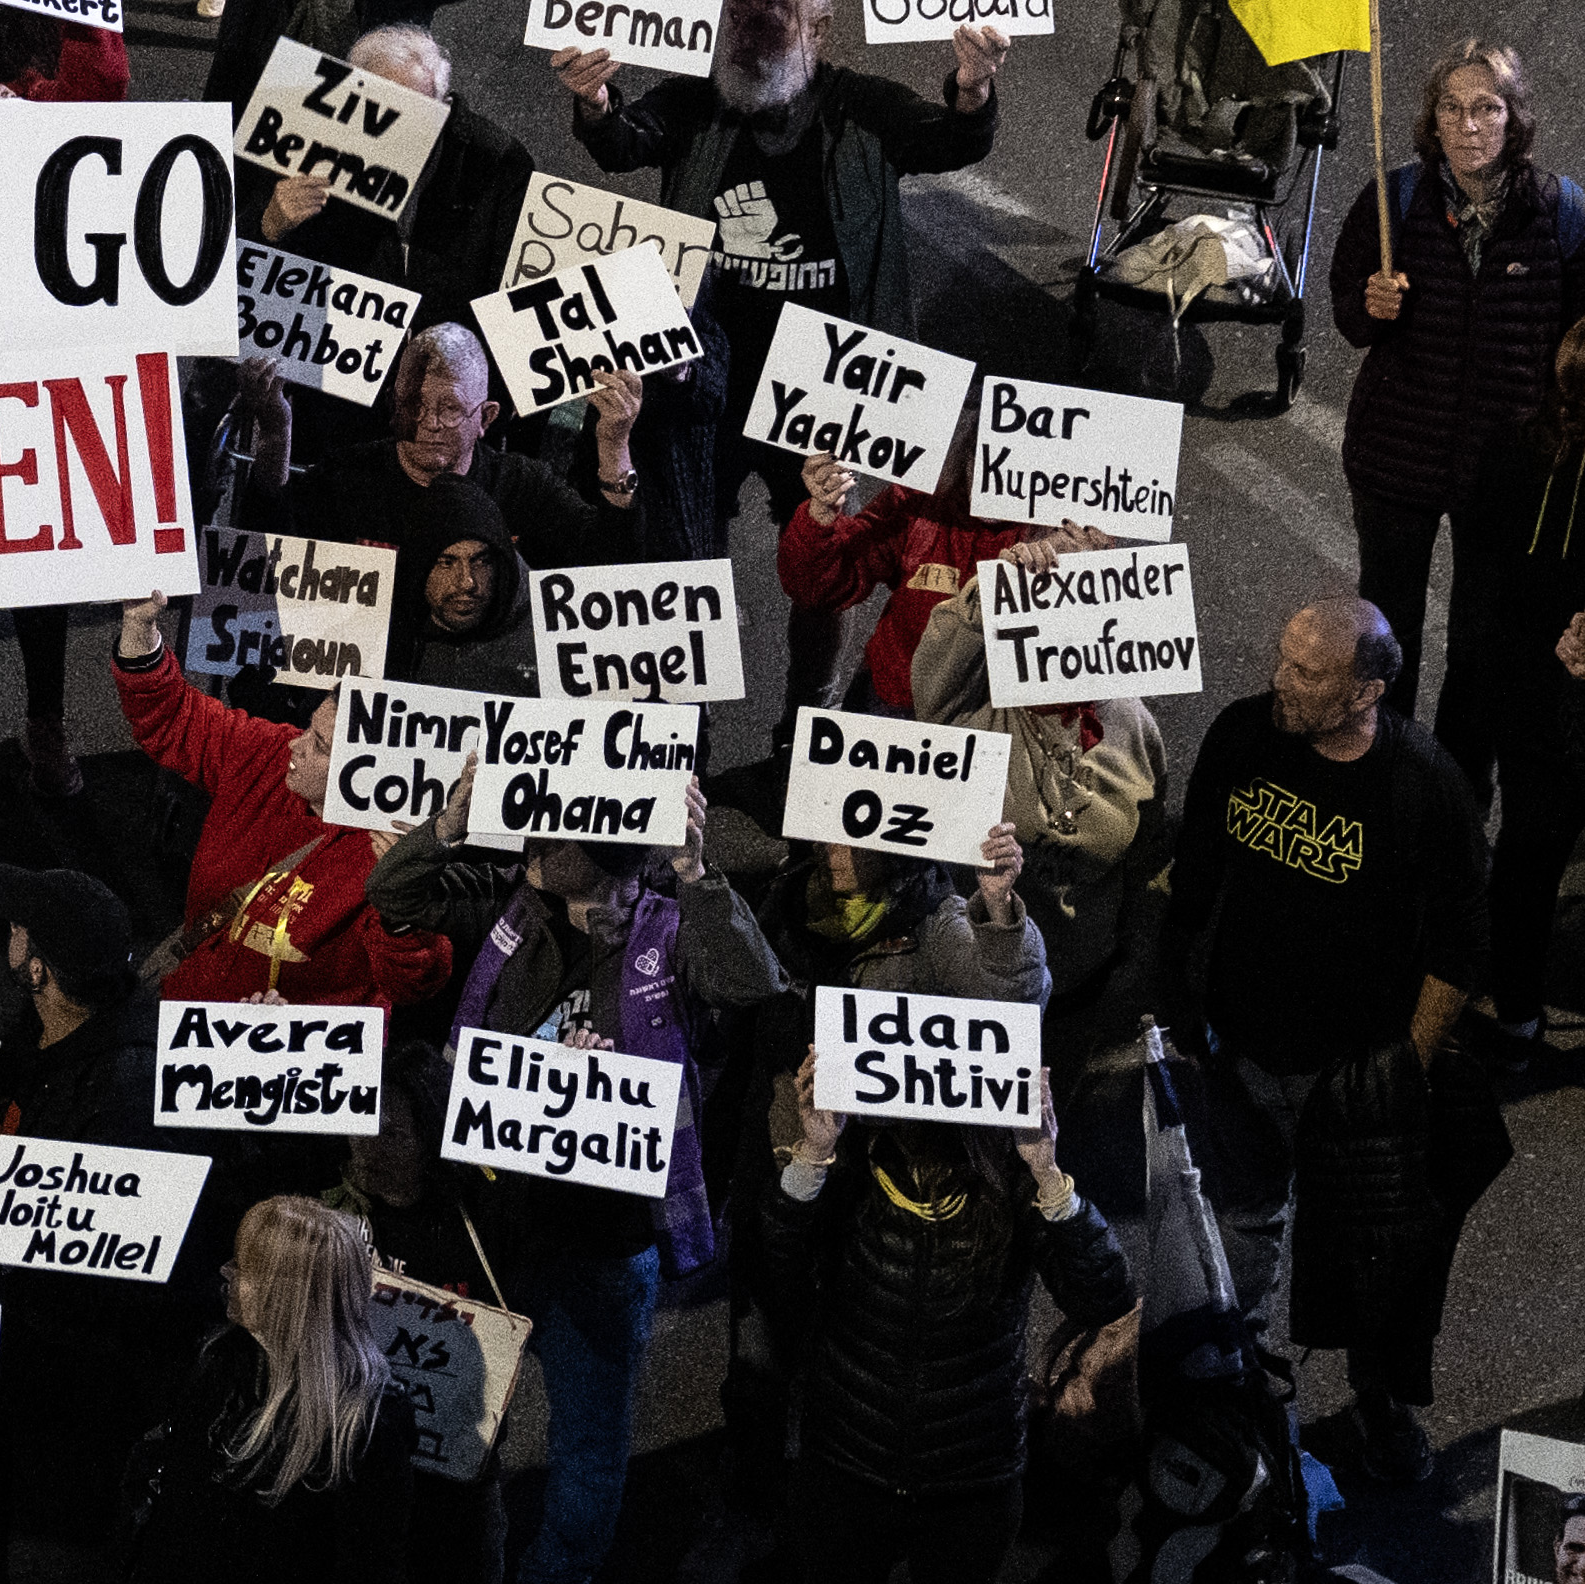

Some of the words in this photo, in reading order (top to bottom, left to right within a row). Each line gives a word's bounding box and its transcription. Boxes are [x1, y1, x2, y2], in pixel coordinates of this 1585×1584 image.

[302, 57, 402, 139] Ziv
[243, 107, 410, 212] Berman
[35, 132, 232, 307] GO
[507, 264, 618, 340] Tal
[823, 321, 927, 404] Yair
[990, 383, 1090, 441] Bar
[539, 573, 722, 632] Ronen
[483, 700, 585, 766] Yosef
[808, 715, 976, 783] Daniel
[501, 769, 658, 836] Ohana
[1227, 797, 1363, 884] WARS
[1229, 777, 1363, 858] STAM
[842, 993, 1011, 1055] Idan
[467, 1036, 659, 1119] Eliyhu
[854, 1050, 1033, 1116] Shtivi
[450, 1096, 667, 1176] Margalit
[21, 1230, 162, 1276] Mollel
